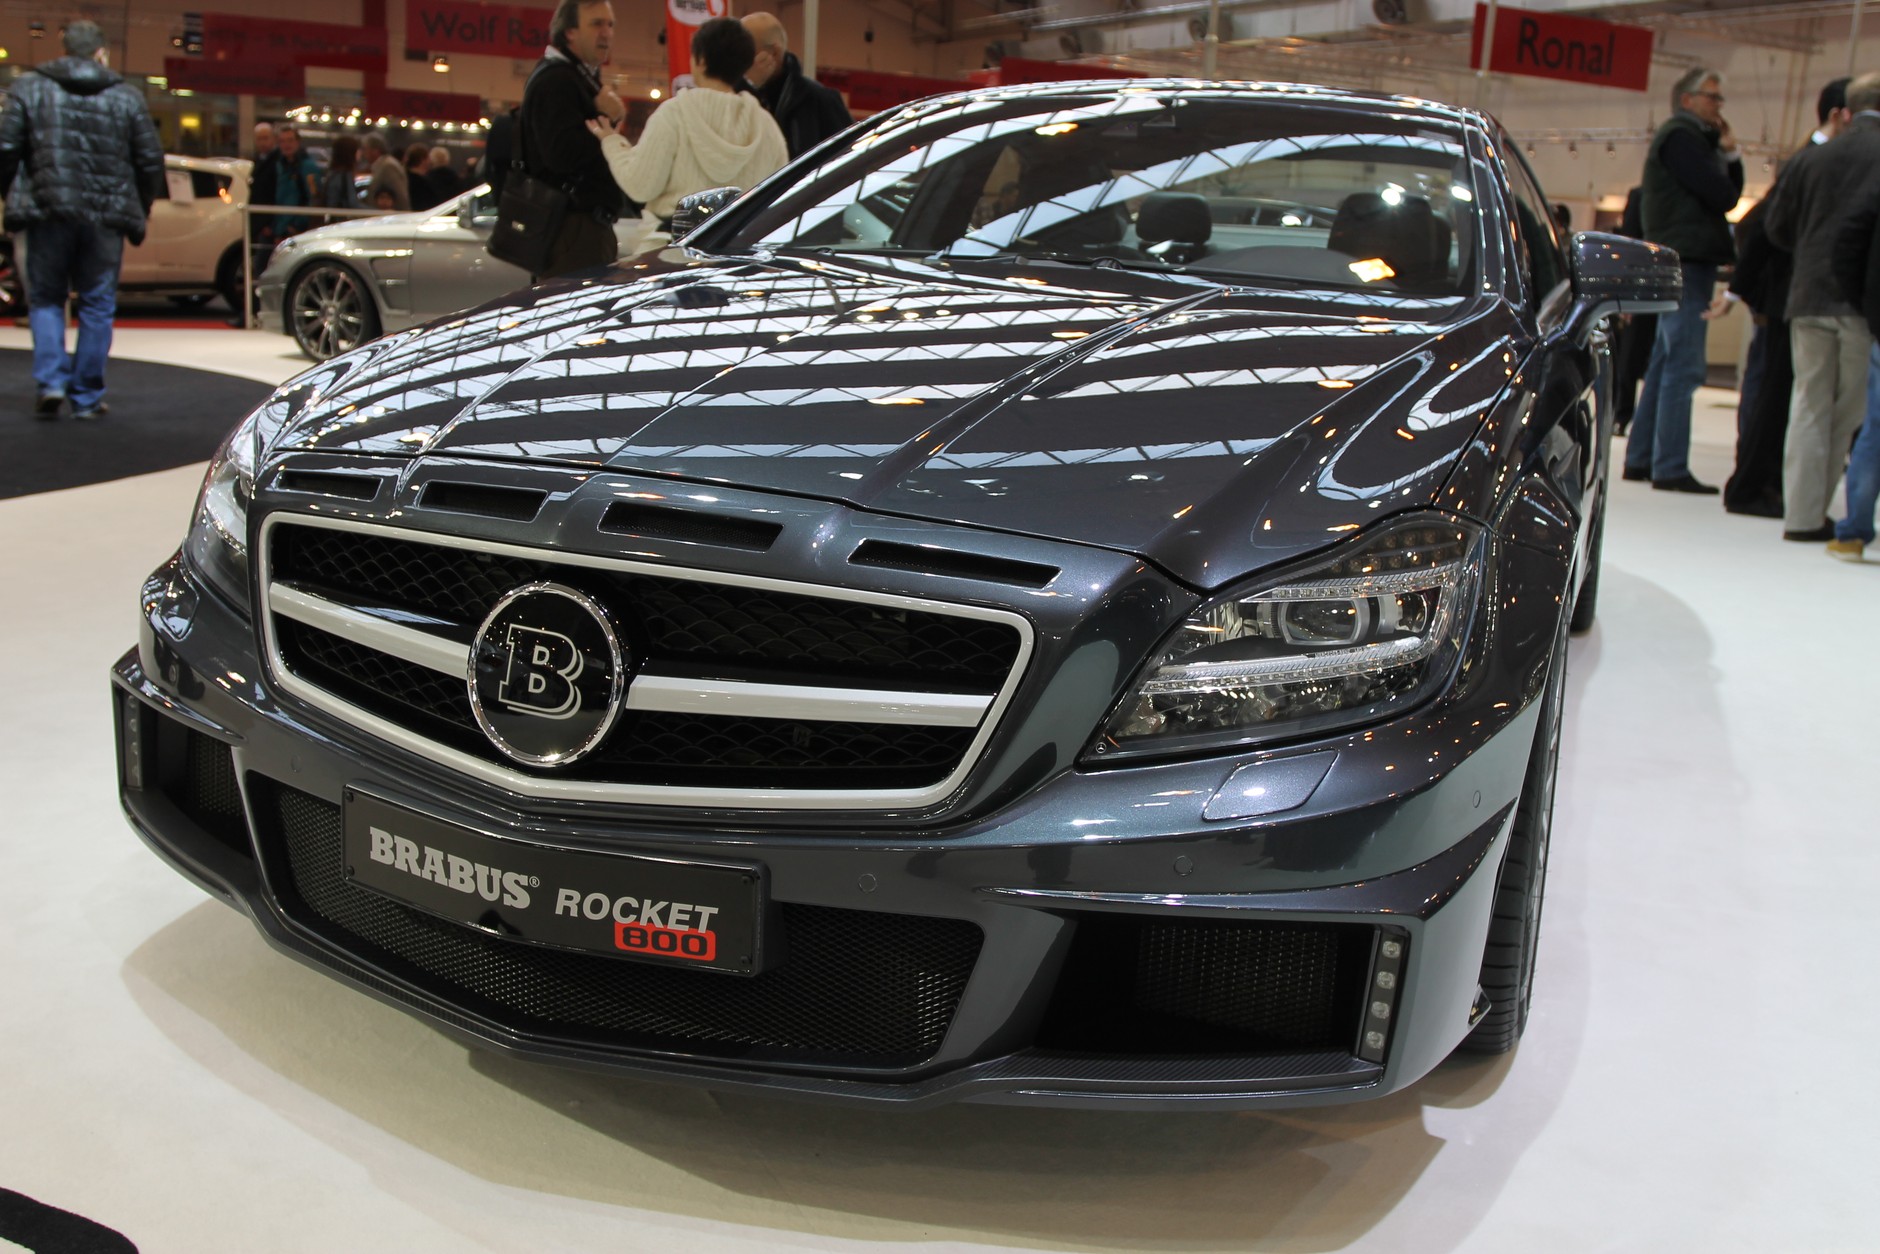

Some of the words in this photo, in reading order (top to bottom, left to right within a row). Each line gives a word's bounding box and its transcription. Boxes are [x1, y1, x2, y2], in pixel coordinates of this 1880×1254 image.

[420, 10, 499, 45] Wolf
[1516, 17, 1616, 76] Ronal
[498, 623, 584, 720] B
[555, 887, 719, 933] ROCKET
[622, 927, 708, 957] 800
